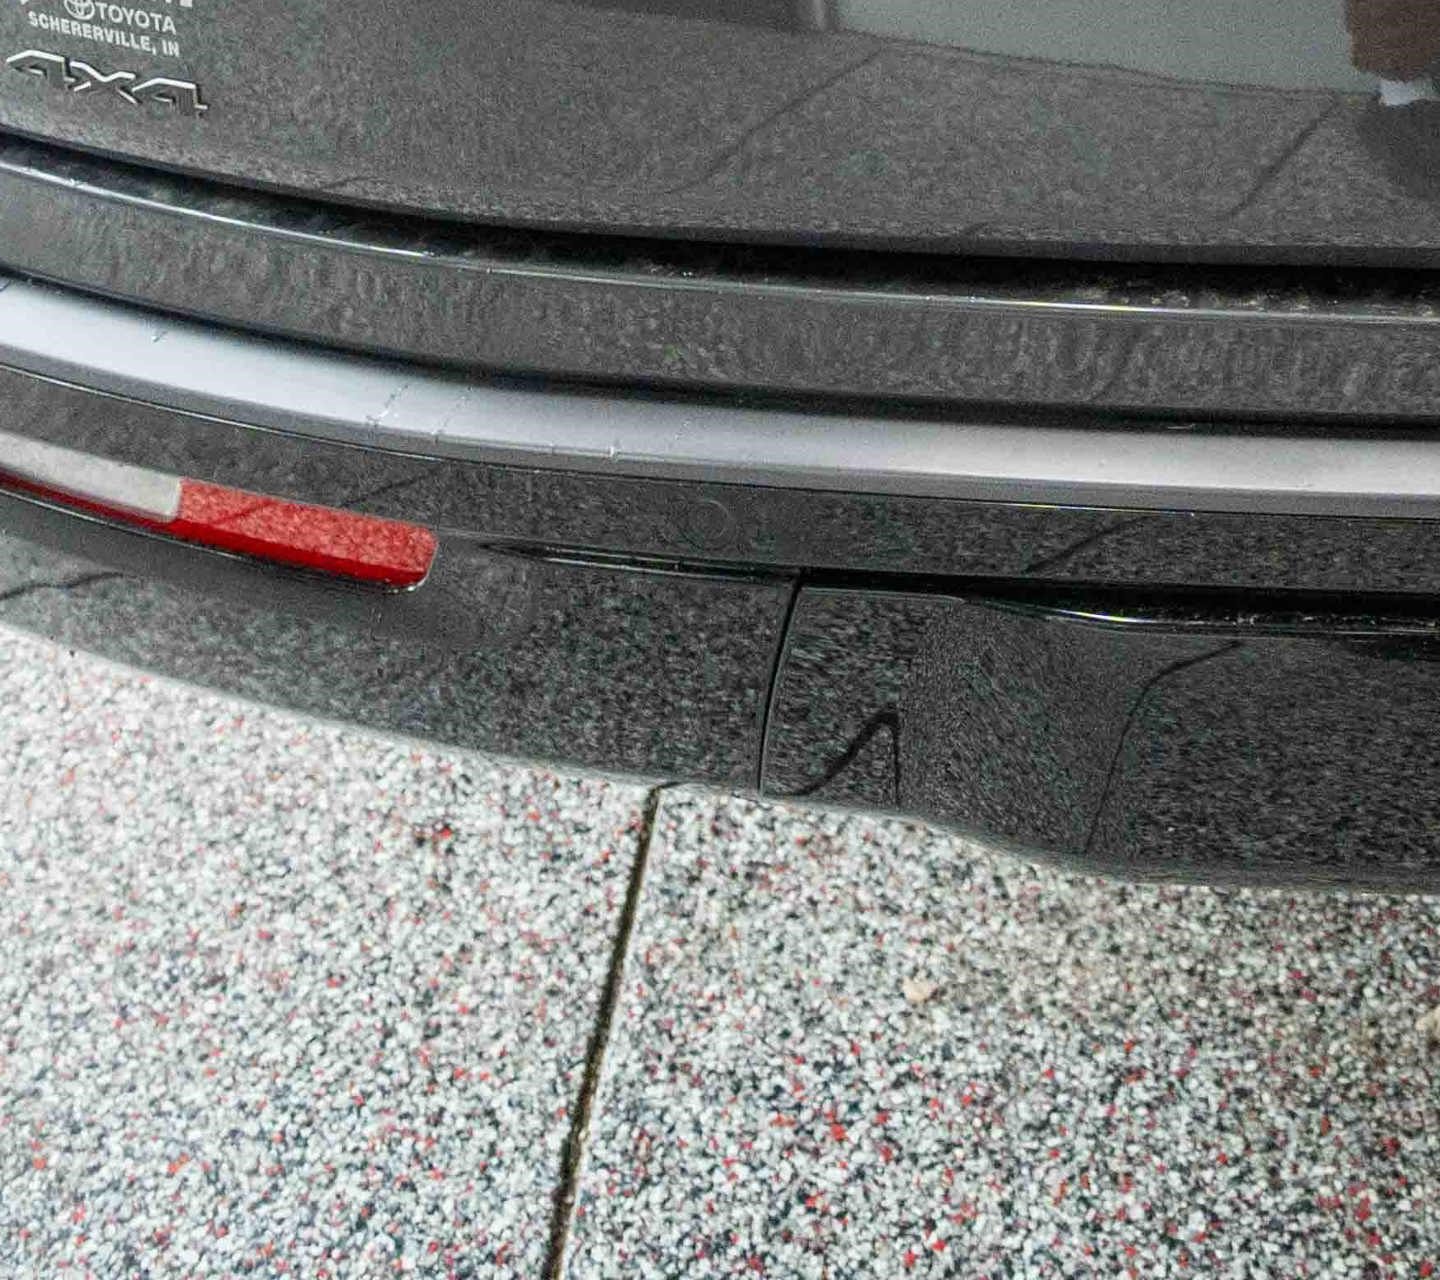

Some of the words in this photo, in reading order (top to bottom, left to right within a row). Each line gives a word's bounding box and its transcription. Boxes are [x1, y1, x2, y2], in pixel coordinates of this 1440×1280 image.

[28, 11, 157, 55] SCHERERVILLE,
[162, 41, 179, 58] IN
[95, 1, 177, 35] TOYOTA
